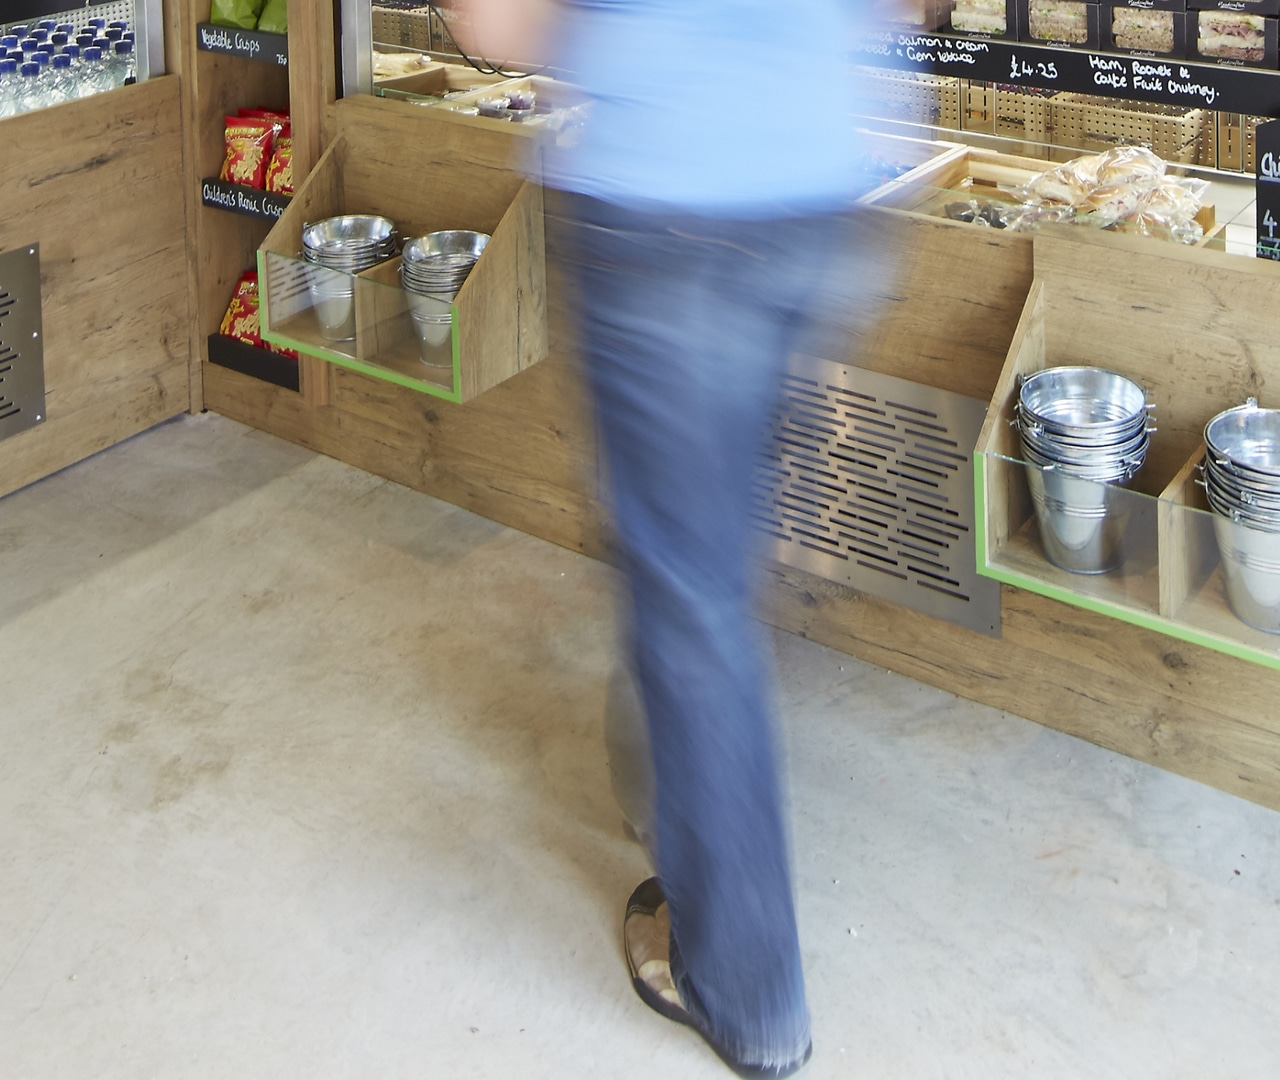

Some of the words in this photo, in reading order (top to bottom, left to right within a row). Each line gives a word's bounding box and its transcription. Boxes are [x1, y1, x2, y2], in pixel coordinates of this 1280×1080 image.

[201, 28, 233, 52] Vegetable
[233, 32, 261, 54] Crisps
[955, 40, 990, 53] cream
[906, 47, 936, 63] Gem
[1088, 54, 1127, 74] Ham,
[1009, 55, 1059, 80] £4.25
[1133, 75, 1163, 92] Fruit
[202, 184, 237, 207] Children's
[1262, 209, 1278, 239] 4
